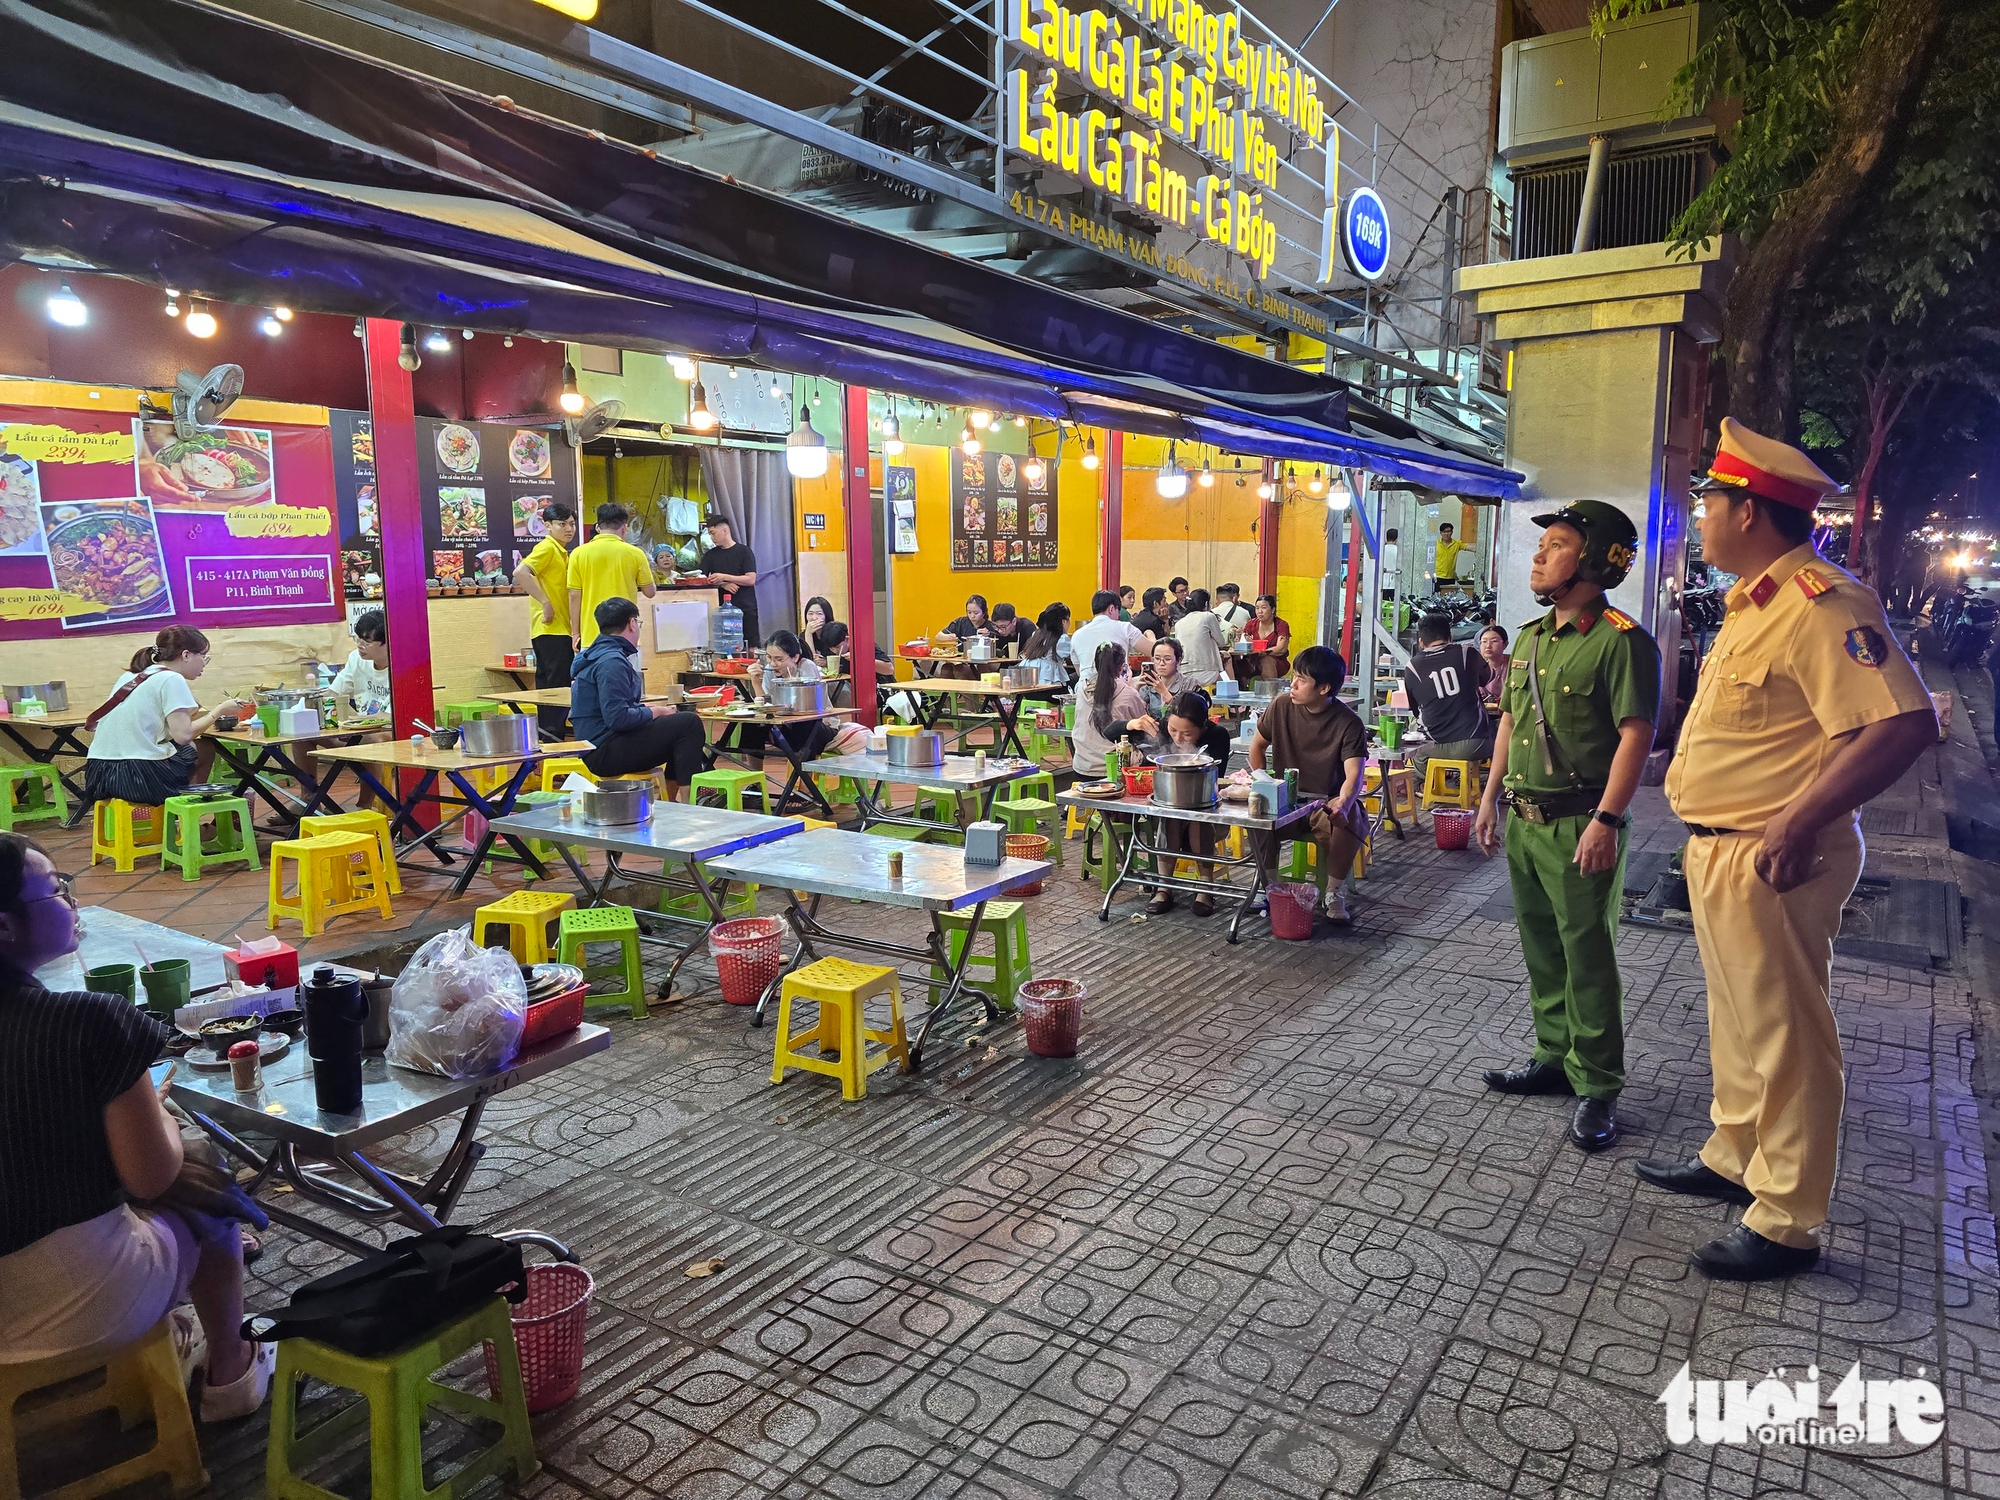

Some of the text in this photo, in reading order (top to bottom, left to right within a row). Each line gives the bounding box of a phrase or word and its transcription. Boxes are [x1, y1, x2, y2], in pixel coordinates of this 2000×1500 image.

[1222, 12, 1262, 110] Cay
[1265, 44, 1290, 118] Hà
[1293, 67, 1324, 149] Nội
[1132, 35, 1163, 122] Lá
[1189, 75, 1235, 163] Phú
[1242, 109, 1277, 190] Yên
[1019, 68, 1079, 174] Lẩu
[1087, 109, 1122, 194] Cá
[1130, 129, 1187, 226] Tầm
[1206, 175, 1231, 246] Cá
[1236, 190, 1276, 280] Bớp
[1356, 211, 1383, 250] 169k
[1009, 189, 1064, 232] 417A
[1069, 213, 1124, 254] PHẠM
[1262, 292, 1289, 320] BÌNH
[1292, 306, 1327, 335] THẠNH
[15, 431, 119, 447] Lẩu cá tầm Đà Lạt
[45, 445, 88, 459] 239k
[228, 511, 245, 519] Lẩu
[261, 512, 278, 520] bớp
[305, 512, 326, 520] Thiết
[805, 515, 815, 525] WC
[262, 522, 293, 534] 189k
[902, 534, 911, 545] 19
[1607, 542, 1634, 568] CS
[196, 570, 216, 581] 415
[223, 569, 251, 580] 417A
[252, 568, 279, 581] Phạm
[280, 568, 299, 579] Văn
[301, 565, 325, 580] Đồng
[28, 594, 41, 602] Hà
[44, 593, 60, 603] Nội
[226, 584, 304, 598] P11, Bình Thạnh
[28, 602, 66, 615] 169k
[1428, 666, 1460, 699] 10
